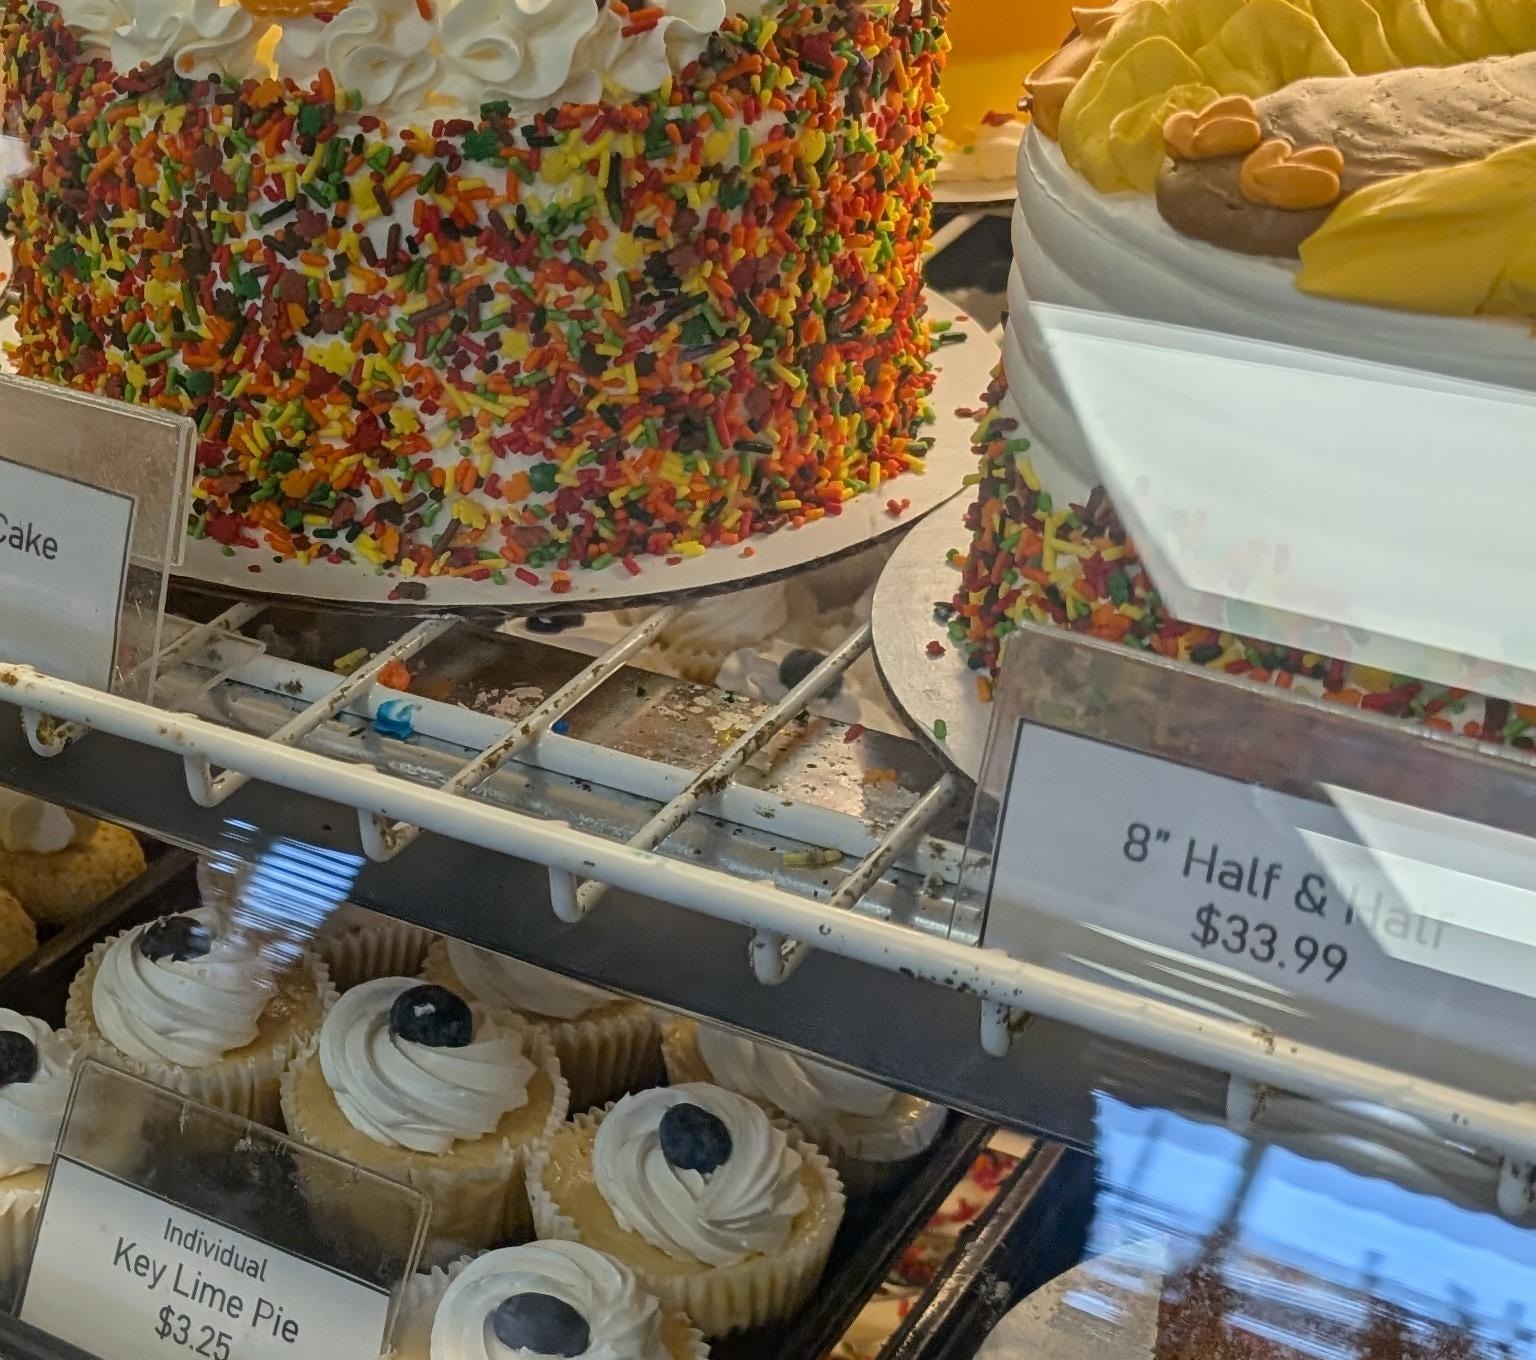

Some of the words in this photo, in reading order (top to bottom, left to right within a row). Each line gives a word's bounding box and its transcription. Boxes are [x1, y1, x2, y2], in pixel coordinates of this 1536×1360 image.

[1122, 822, 1171, 862] 8"
[1181, 838, 1283, 901] Half
[1293, 873, 1329, 918] &
[1191, 902, 1349, 984] $33.99
[113, 1237, 168, 1292] Key
[172, 1262, 244, 1320] Lime
[251, 1297, 299, 1344] Pie
[163, 1217, 268, 1283] Individual
